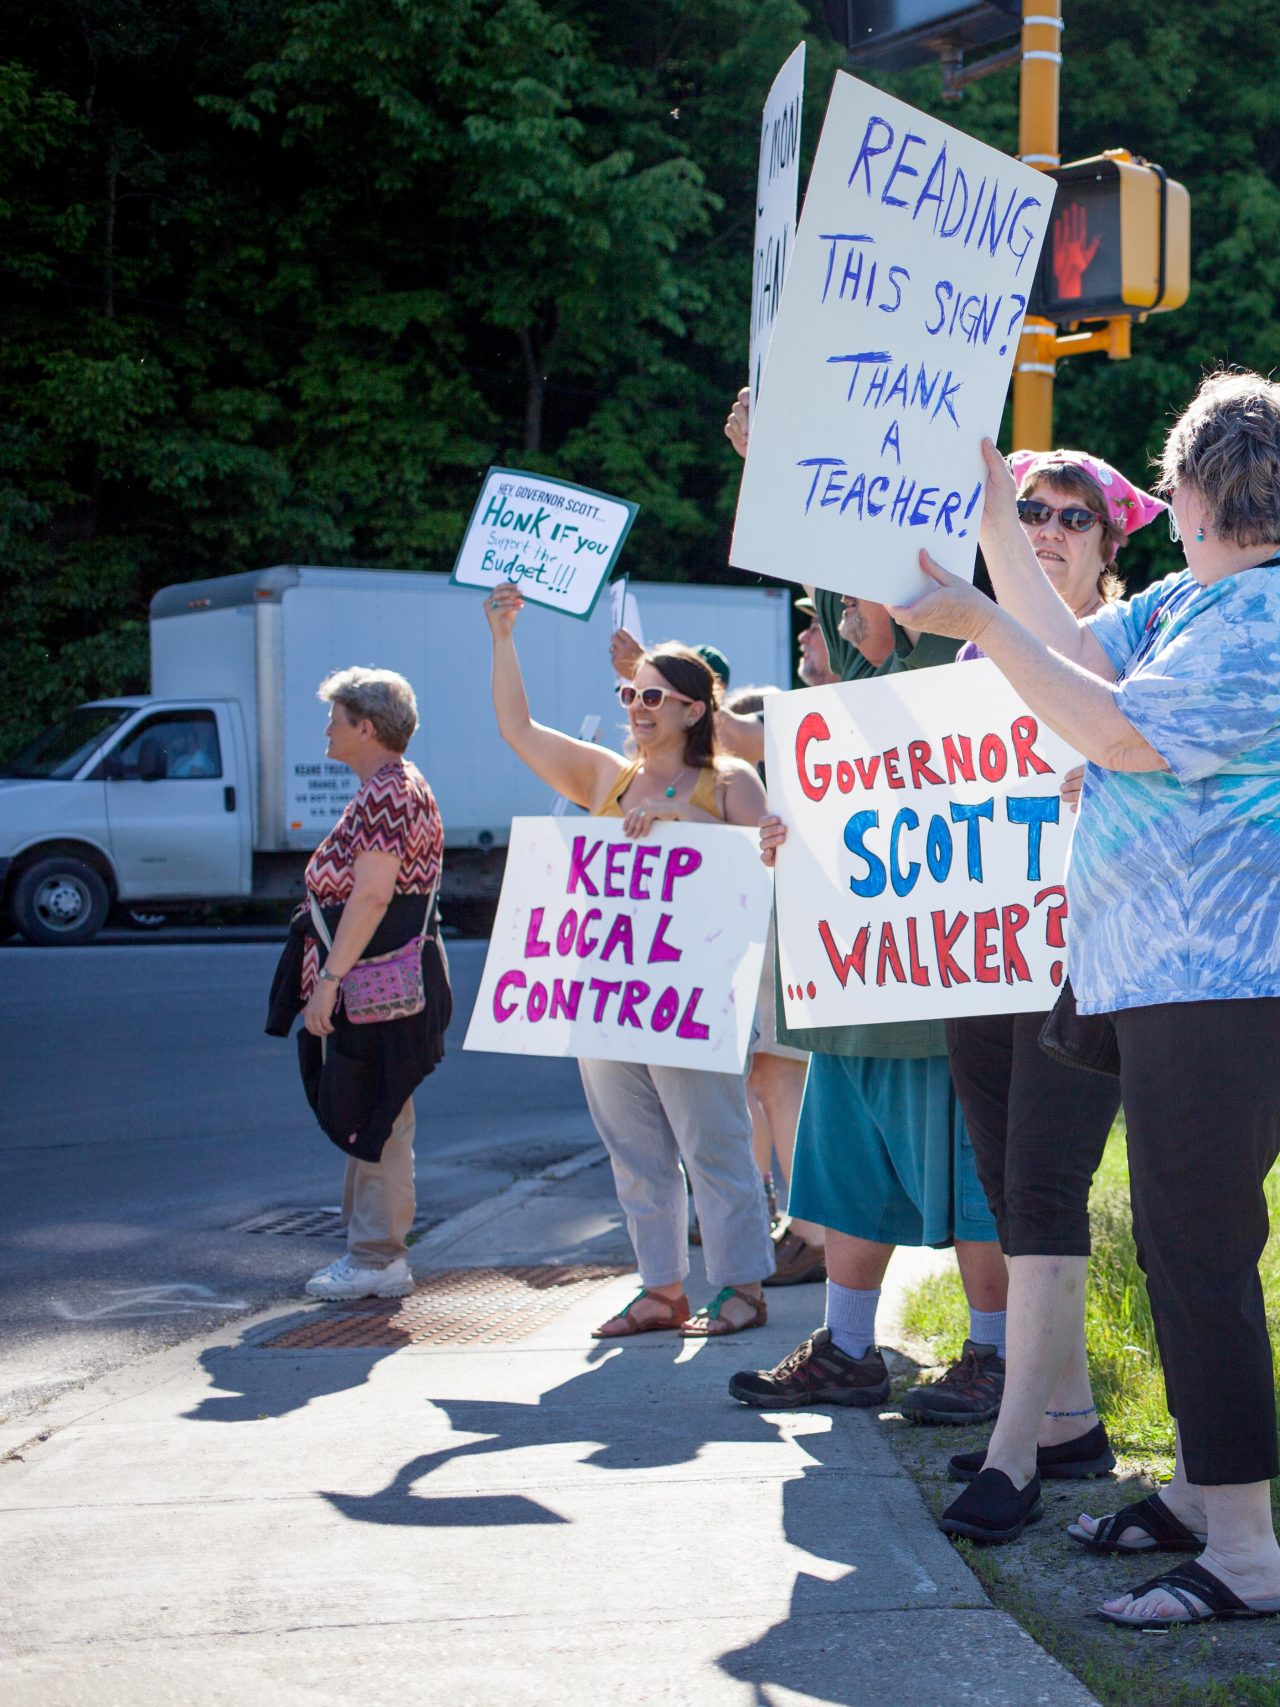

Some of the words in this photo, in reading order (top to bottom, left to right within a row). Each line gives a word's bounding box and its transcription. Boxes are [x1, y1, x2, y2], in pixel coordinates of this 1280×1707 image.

[848, 115, 1041, 276] READING
[819, 233, 910, 312] THIS
[925, 280, 1026, 356] SIGN?
[826, 351, 963, 429] THANK
[880, 419, 901, 464] A
[515, 485, 566, 508] GOVERNOR
[550, 523, 579, 543] IF
[796, 457, 982, 538] TEACHER!
[794, 712, 1056, 802] GOVERNOR
[566, 836, 702, 902] KEEP
[843, 796, 1060, 898] SCOTT
[524, 907, 683, 965] LOCAL
[493, 969, 710, 1040] CONTROL
